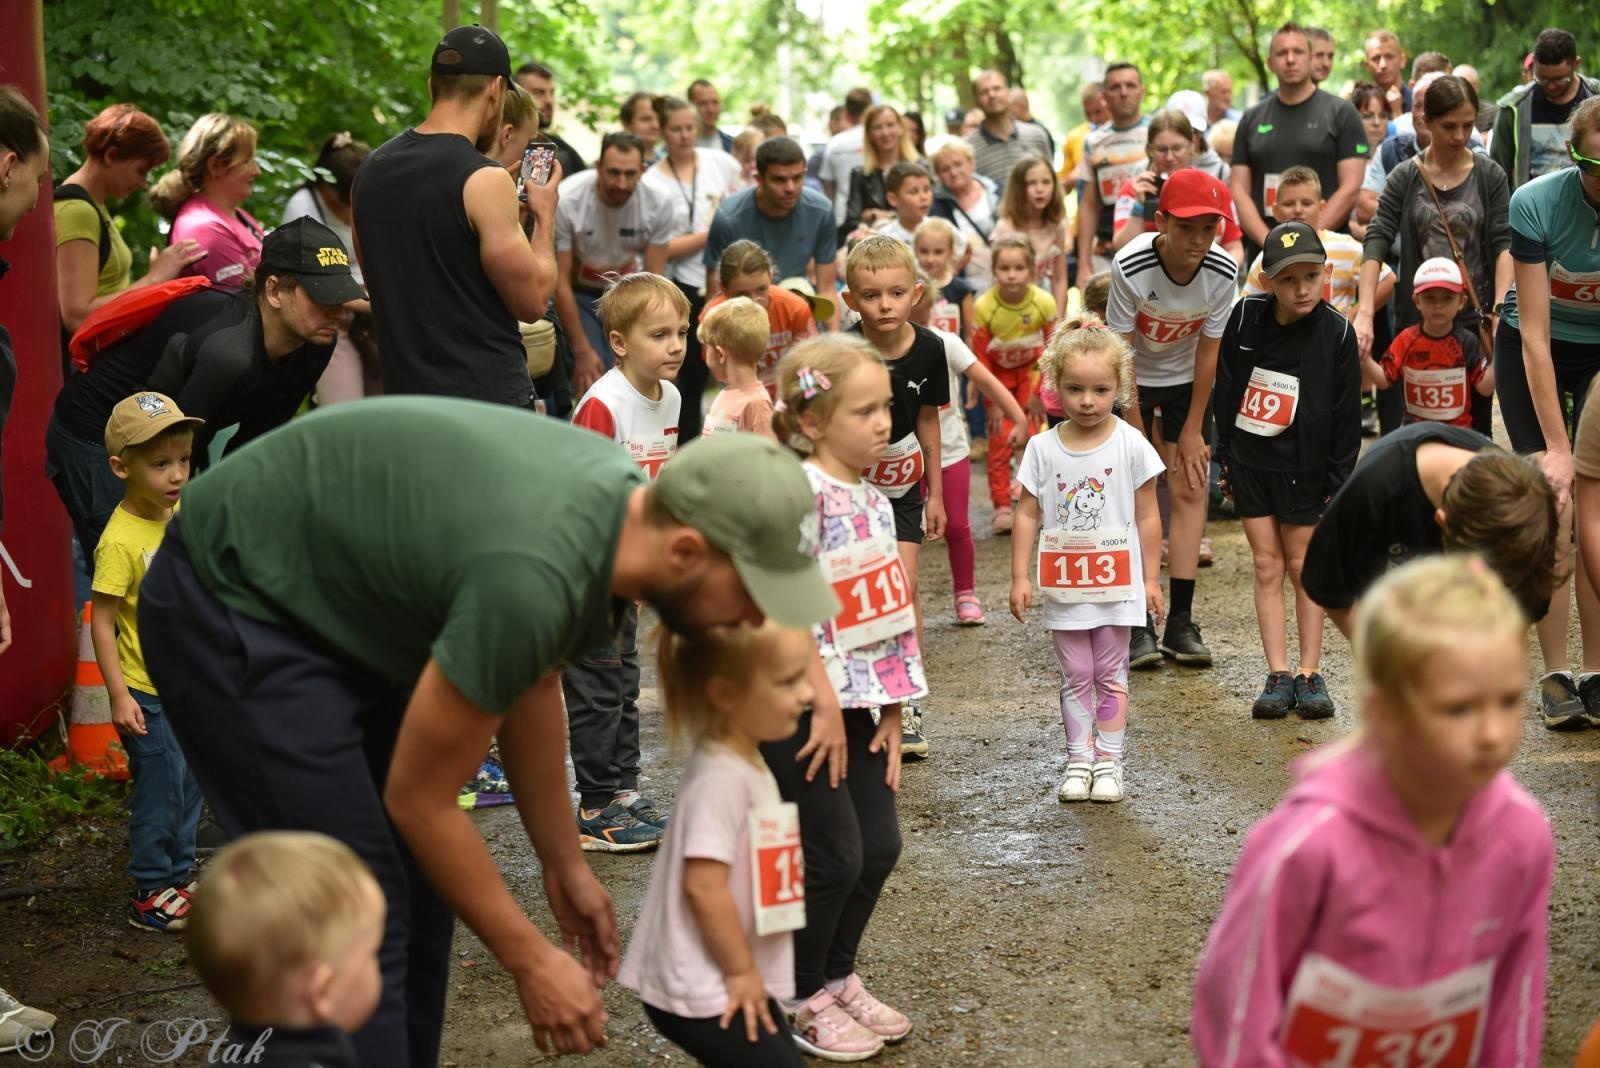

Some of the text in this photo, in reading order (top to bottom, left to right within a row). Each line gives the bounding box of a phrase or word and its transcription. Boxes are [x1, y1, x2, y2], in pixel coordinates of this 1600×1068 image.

[1145, 320, 1194, 341] 176
[1272, 380, 1289, 390] 4500
[1413, 386, 1455, 408] 135
[1241, 387, 1281, 420] 149
[864, 457, 915, 485] 159
[1100, 538, 1119, 547] 4500
[1119, 537, 1128, 545] M
[1053, 554, 1117, 585] 113
[850, 564, 907, 621] 119
